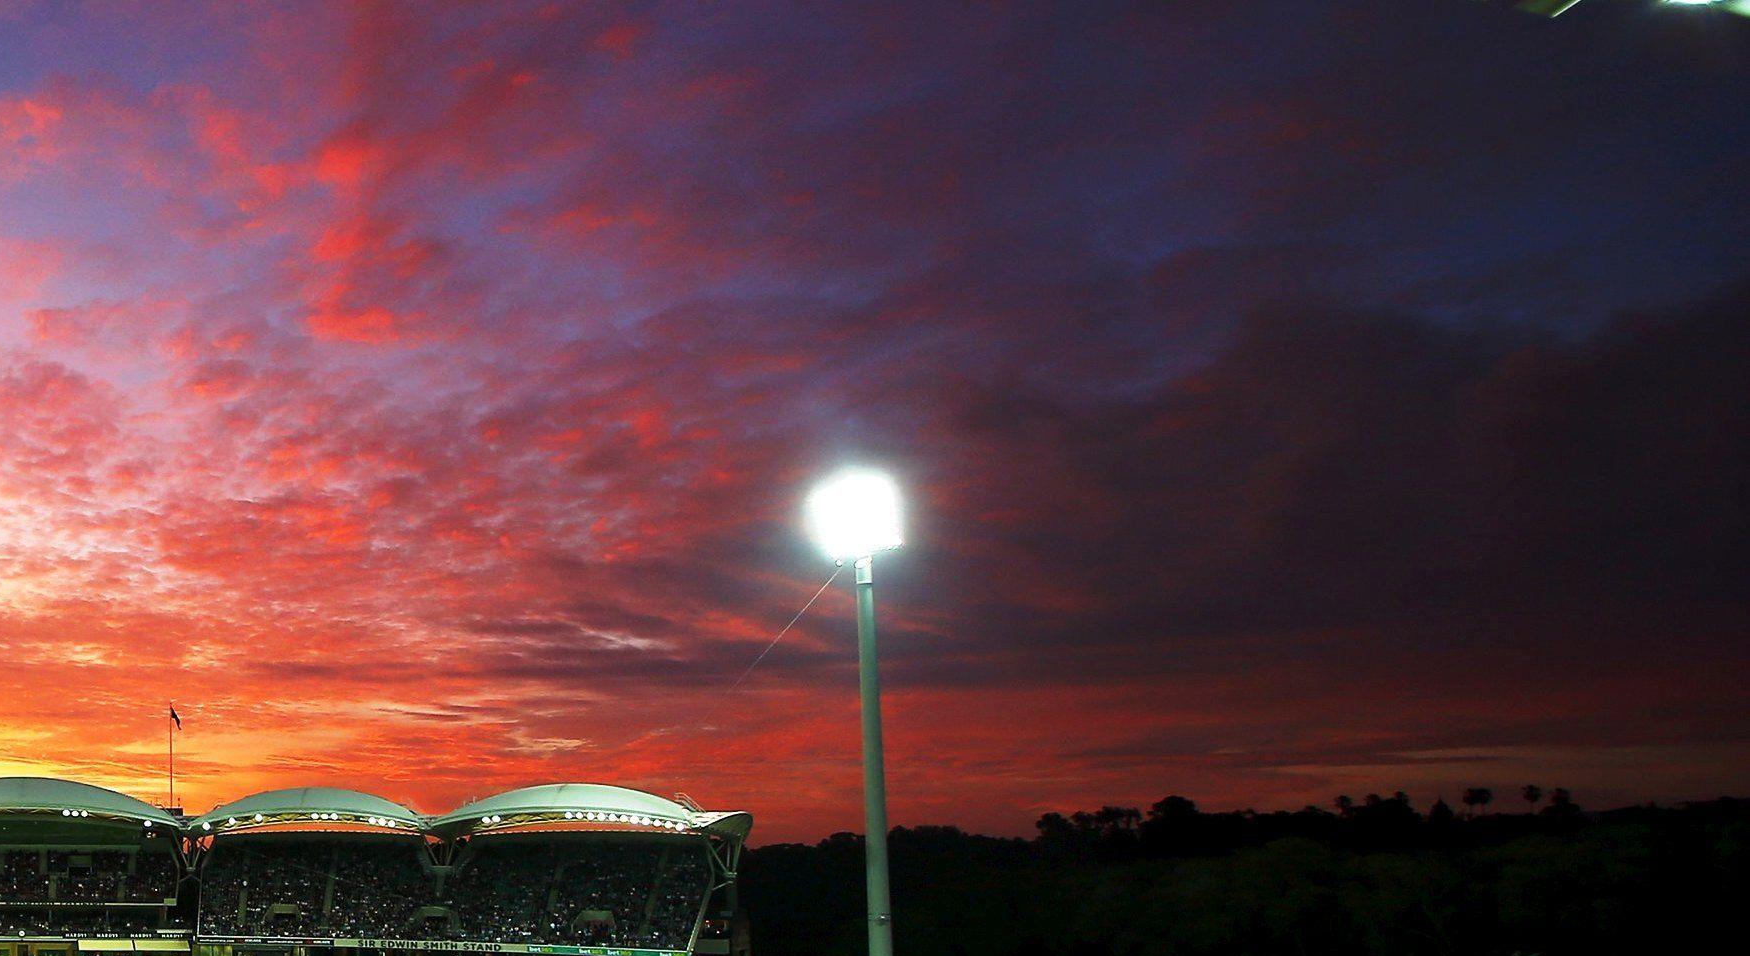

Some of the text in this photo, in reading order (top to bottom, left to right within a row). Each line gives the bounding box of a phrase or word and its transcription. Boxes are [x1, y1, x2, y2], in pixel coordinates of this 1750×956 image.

[358, 939, 501, 951] SIR EDWIN SMITH STAND
